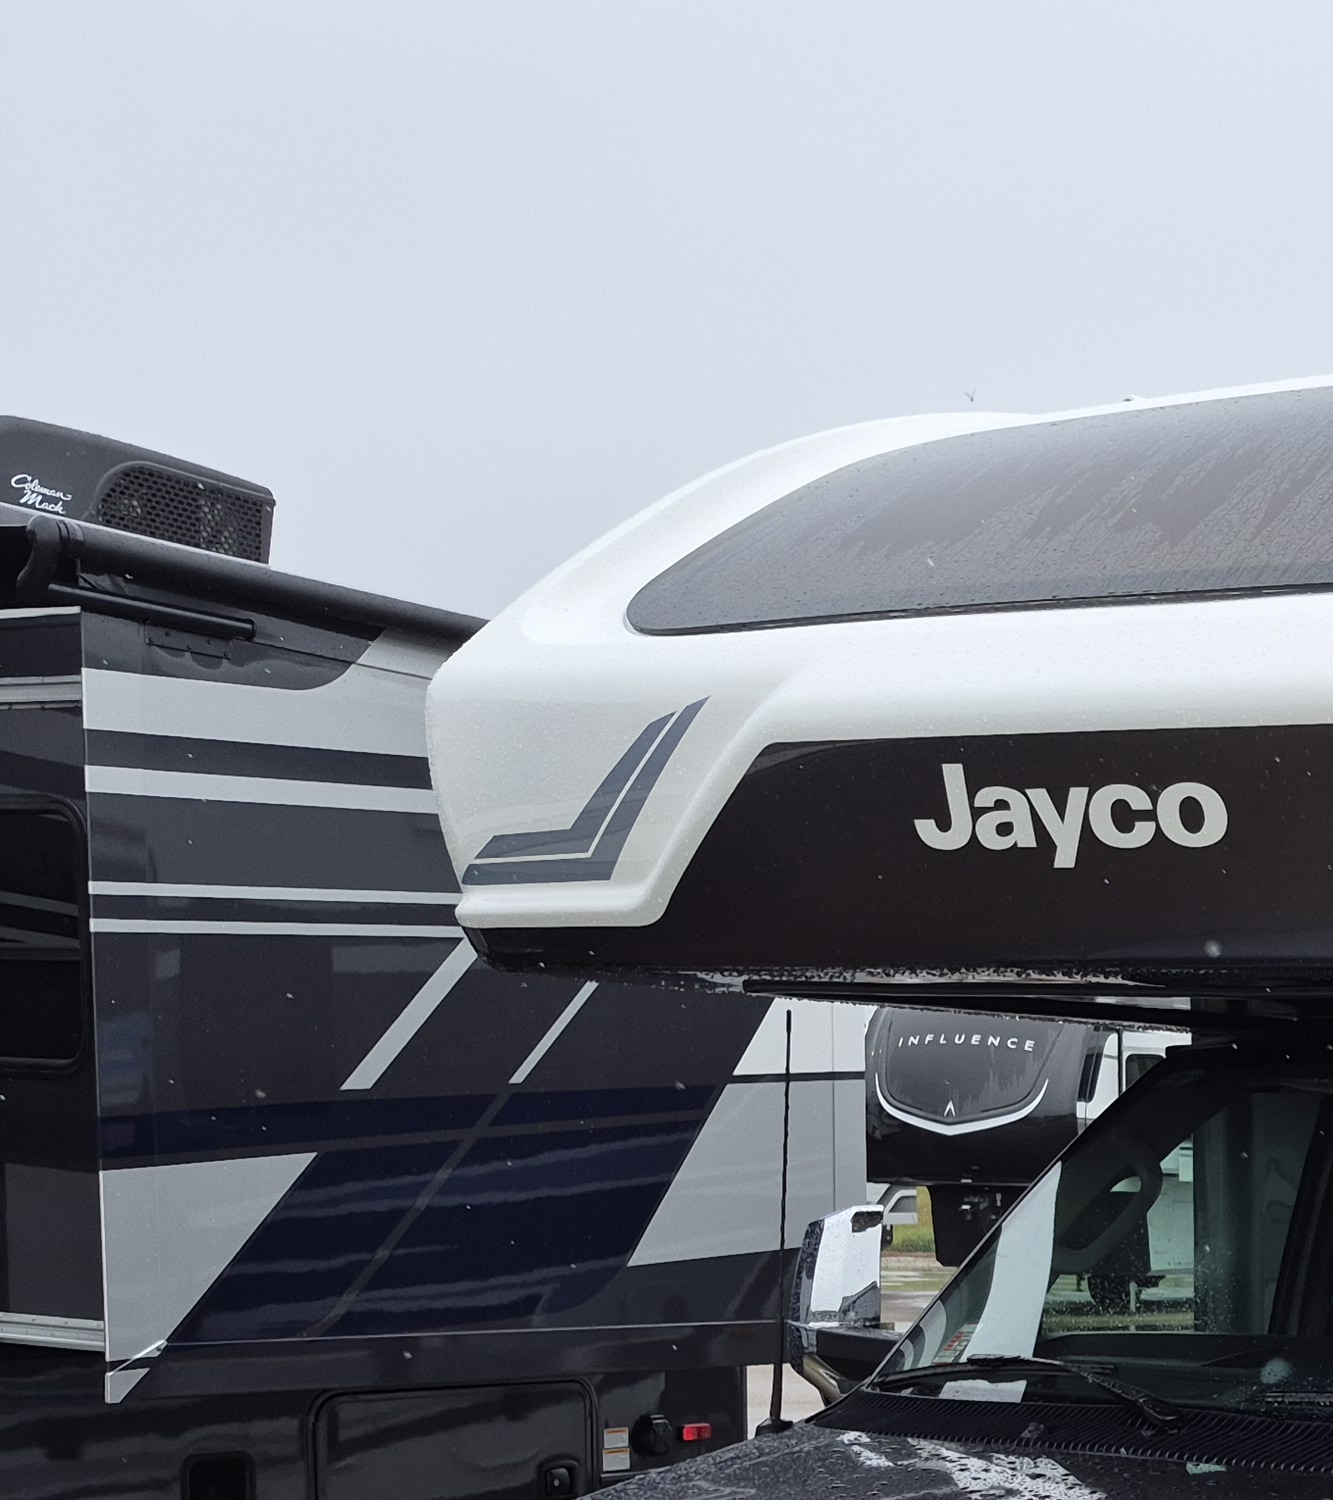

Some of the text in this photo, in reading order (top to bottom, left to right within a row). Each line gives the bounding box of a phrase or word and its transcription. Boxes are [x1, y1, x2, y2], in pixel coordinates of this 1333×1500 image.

[19, 490, 66, 514] Mach
[913, 763, 1229, 869] Jayco
[898, 1033, 1036, 1052] INFLUENCE
